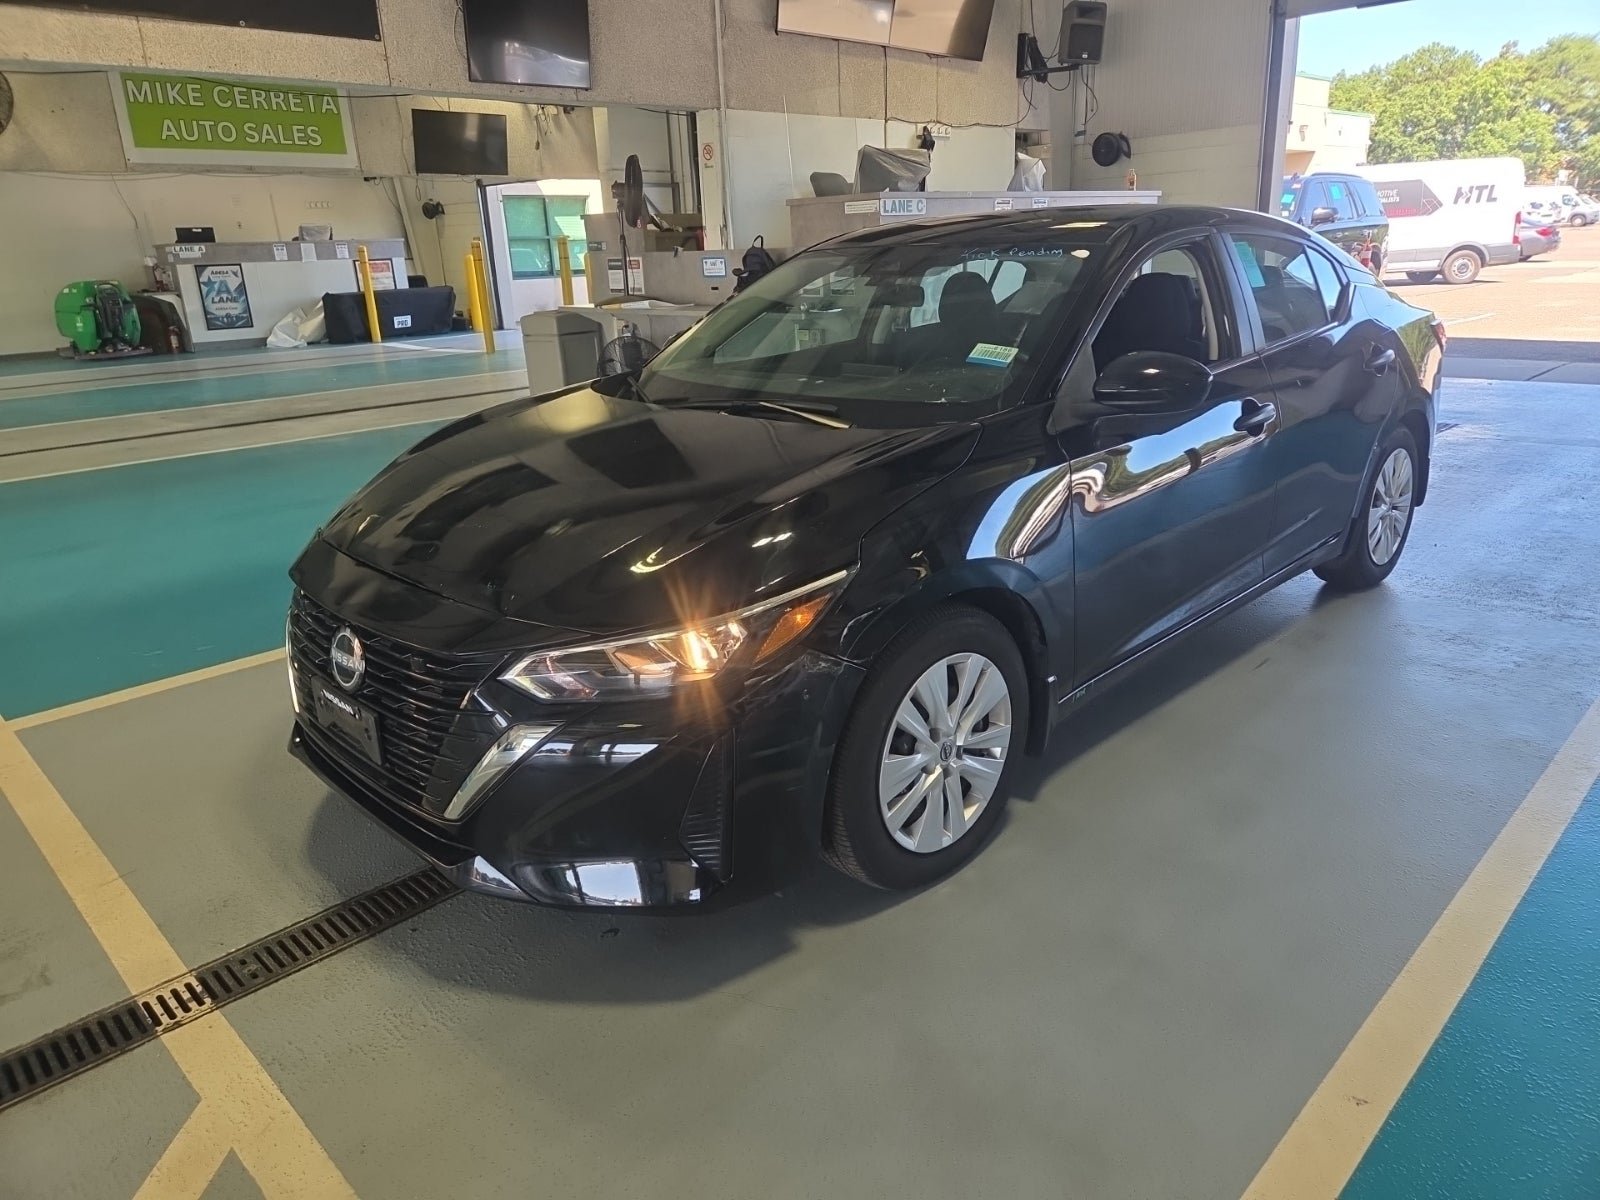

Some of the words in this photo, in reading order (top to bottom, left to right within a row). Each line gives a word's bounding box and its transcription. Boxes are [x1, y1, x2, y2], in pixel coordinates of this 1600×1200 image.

[125, 79, 204, 106] MIKE
[212, 85, 339, 114] CERRETA
[161, 118, 237, 142] AUTO
[243, 122, 322, 146] SALES
[1453, 184, 1498, 204] HTL
[883, 199, 913, 214] LANE
[916, 199, 924, 213] C
[173, 245, 196, 253] LANE
[211, 295, 240, 304] LANE
[332, 645, 365, 674] NISSAN
